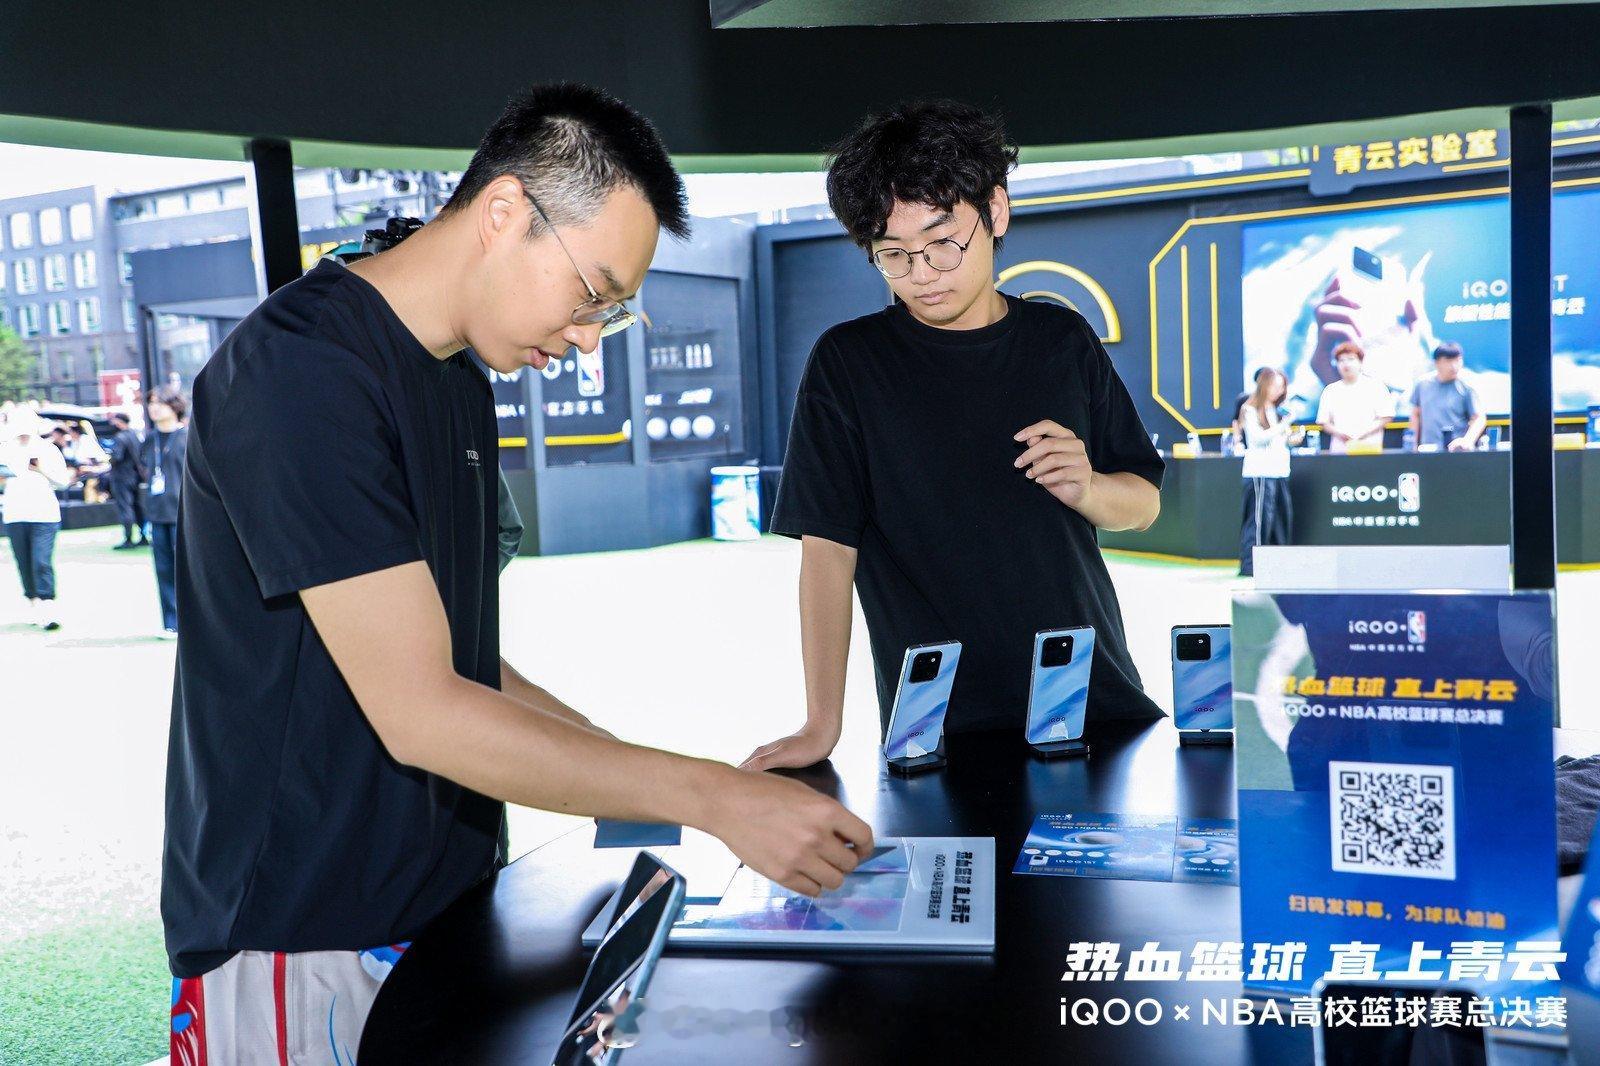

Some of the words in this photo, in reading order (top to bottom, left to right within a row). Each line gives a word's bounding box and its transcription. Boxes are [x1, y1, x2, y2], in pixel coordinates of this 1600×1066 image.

[1333, 129, 1497, 175] 青云实验室
[1462, 279, 1509, 299] iQO
[1393, 678, 1518, 701] 直上青云
